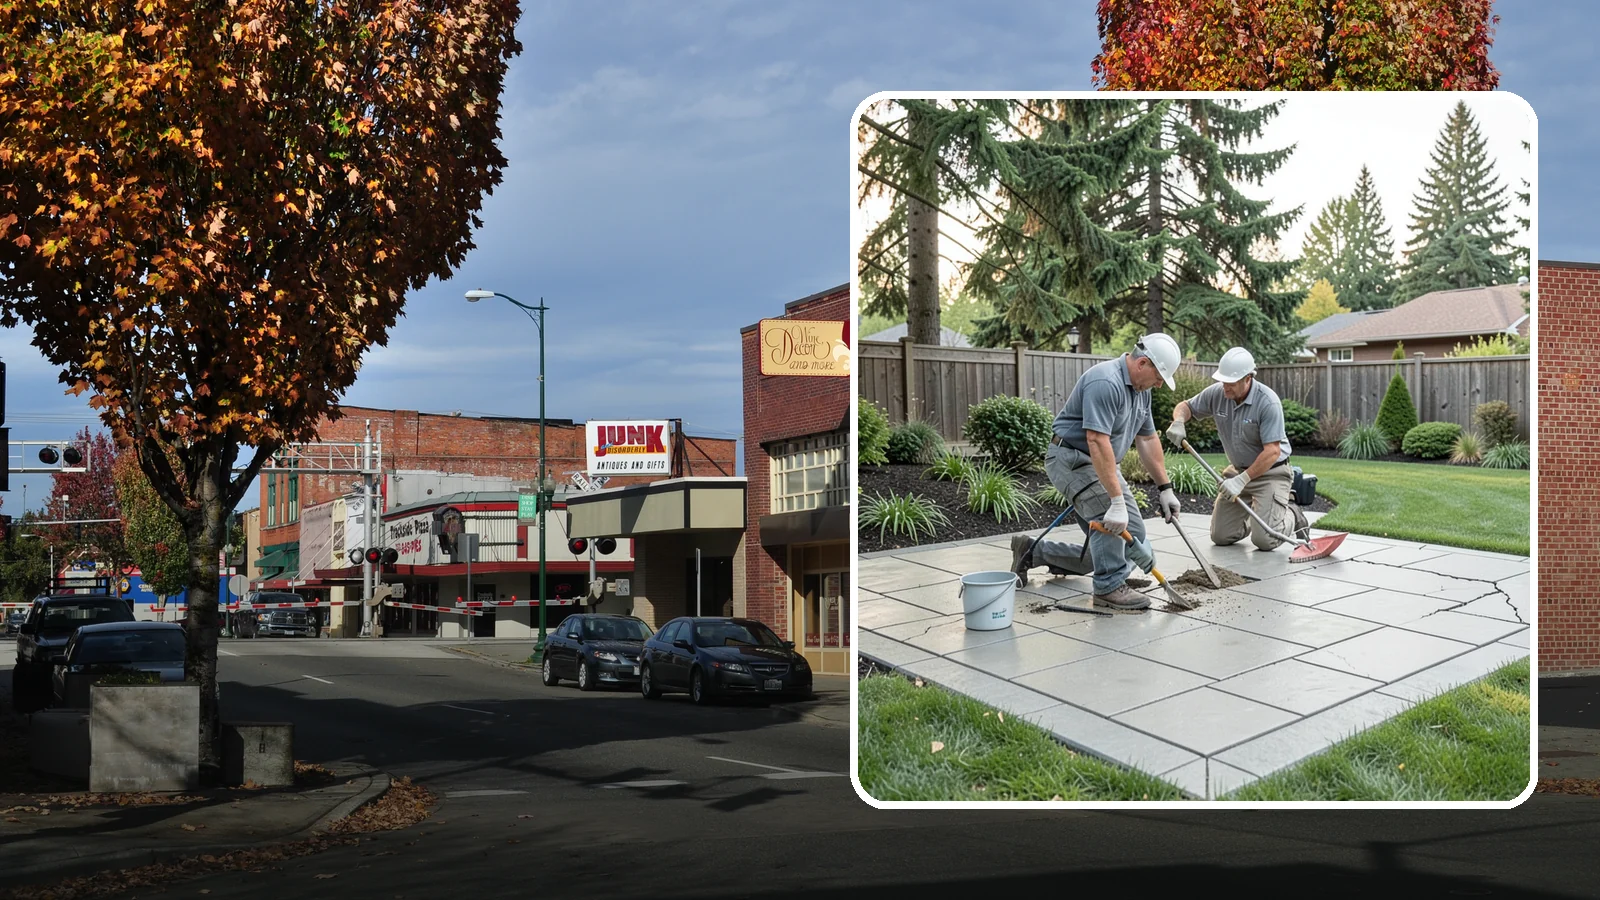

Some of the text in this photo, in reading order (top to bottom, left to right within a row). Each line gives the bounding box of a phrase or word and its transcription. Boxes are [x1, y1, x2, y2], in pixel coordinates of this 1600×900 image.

[595, 425, 665, 457] JUNK
[607, 446, 646, 454] DISORDERLY
[596, 460, 665, 470] ANTIQUES AND GIFTS
[390, 519, 429, 540] Trackside Pizza
